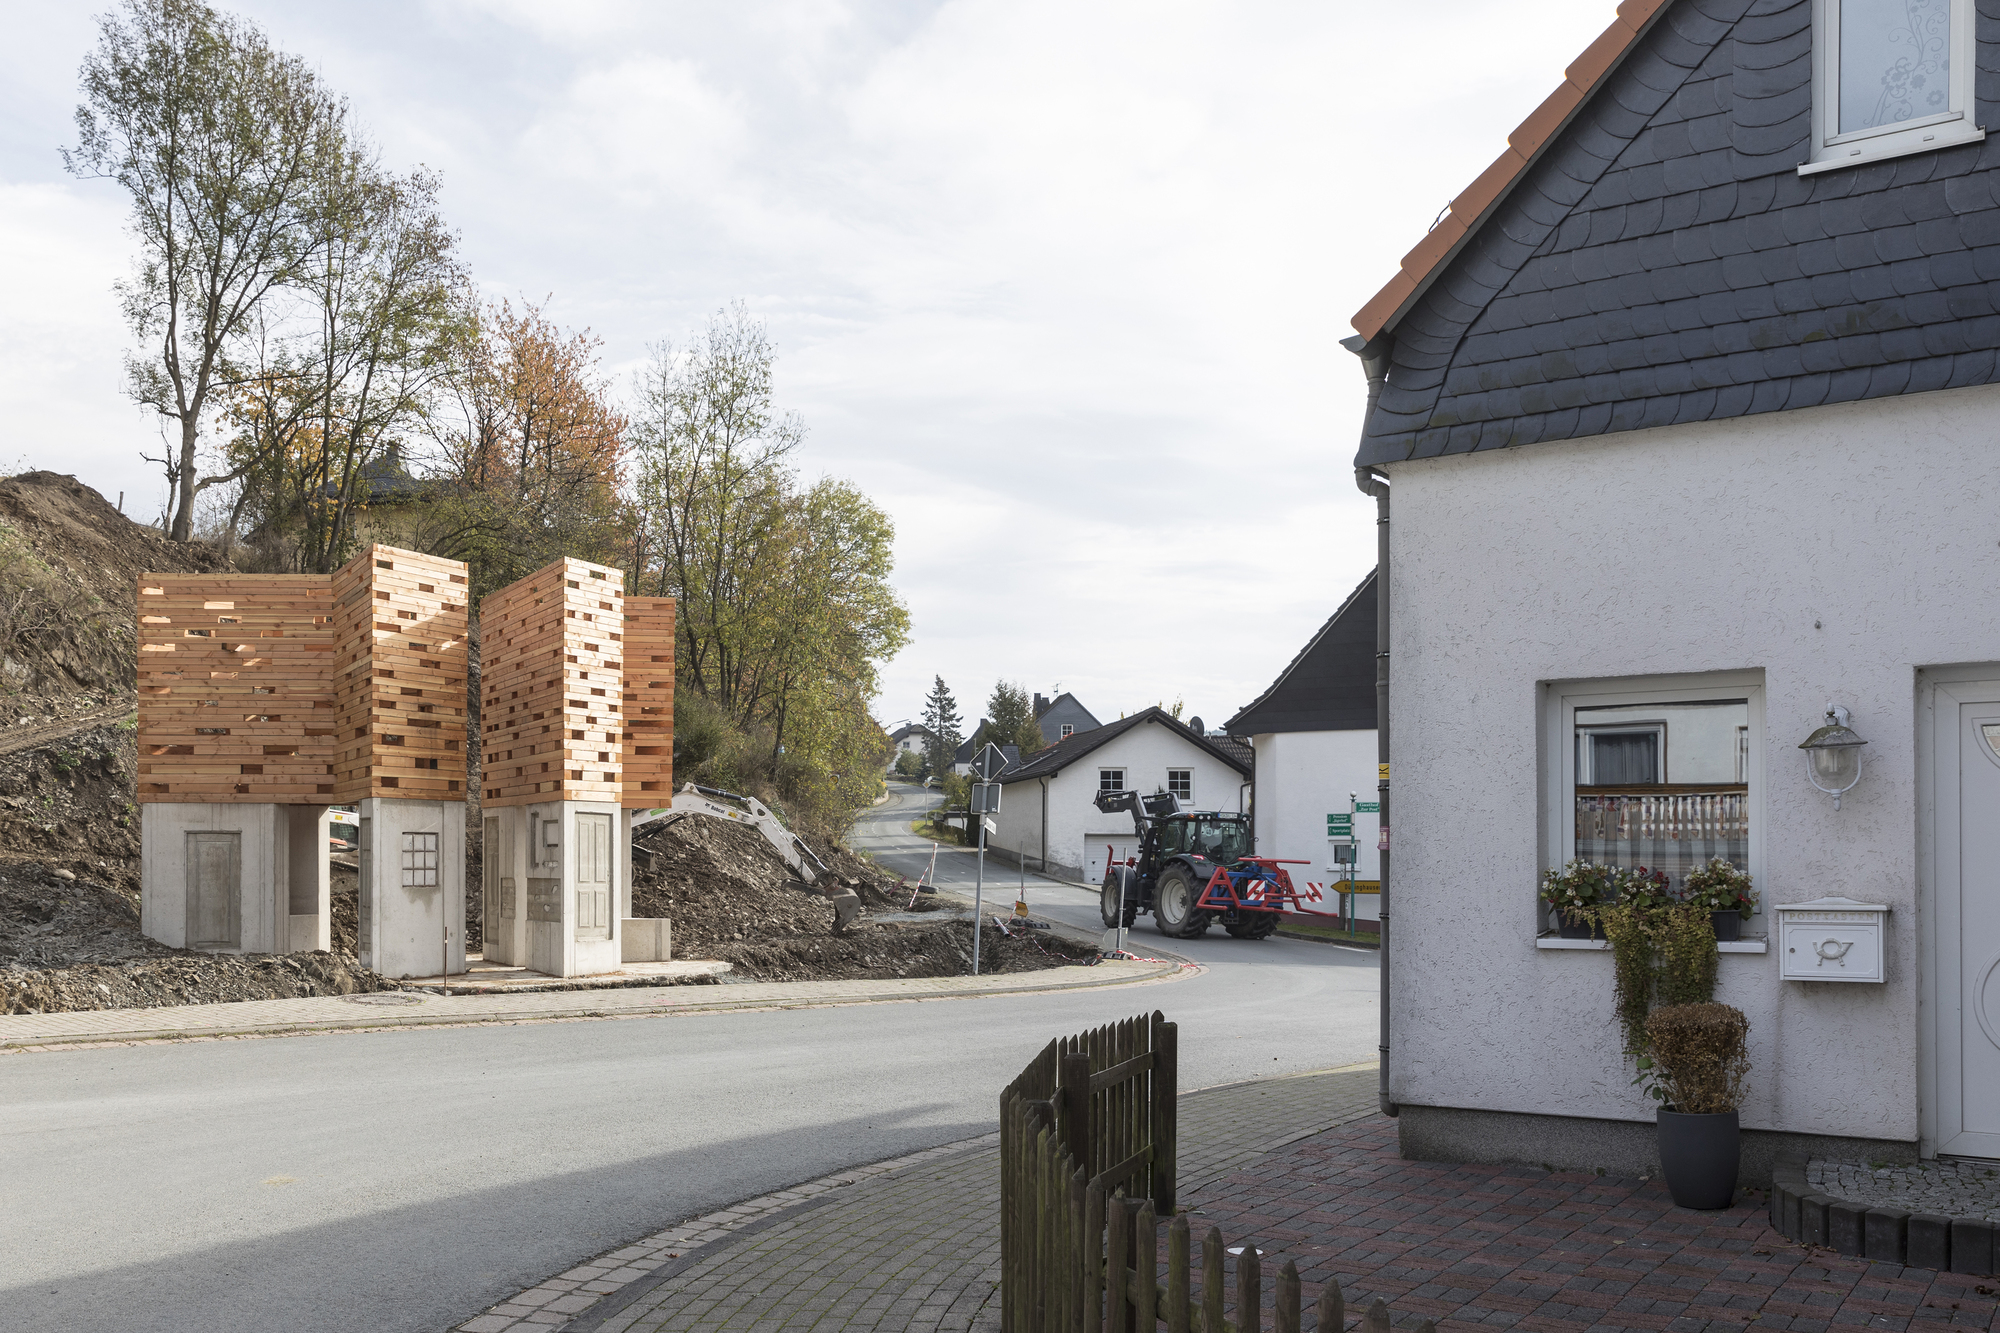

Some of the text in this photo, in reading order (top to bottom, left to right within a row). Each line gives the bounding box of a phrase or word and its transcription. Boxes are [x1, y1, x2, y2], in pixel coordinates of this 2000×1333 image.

[711, 805, 725, 814] Bobcat
[1345, 883, 1380, 891] Düinghause
[1789, 912, 1874, 920] POSTKASTEN
